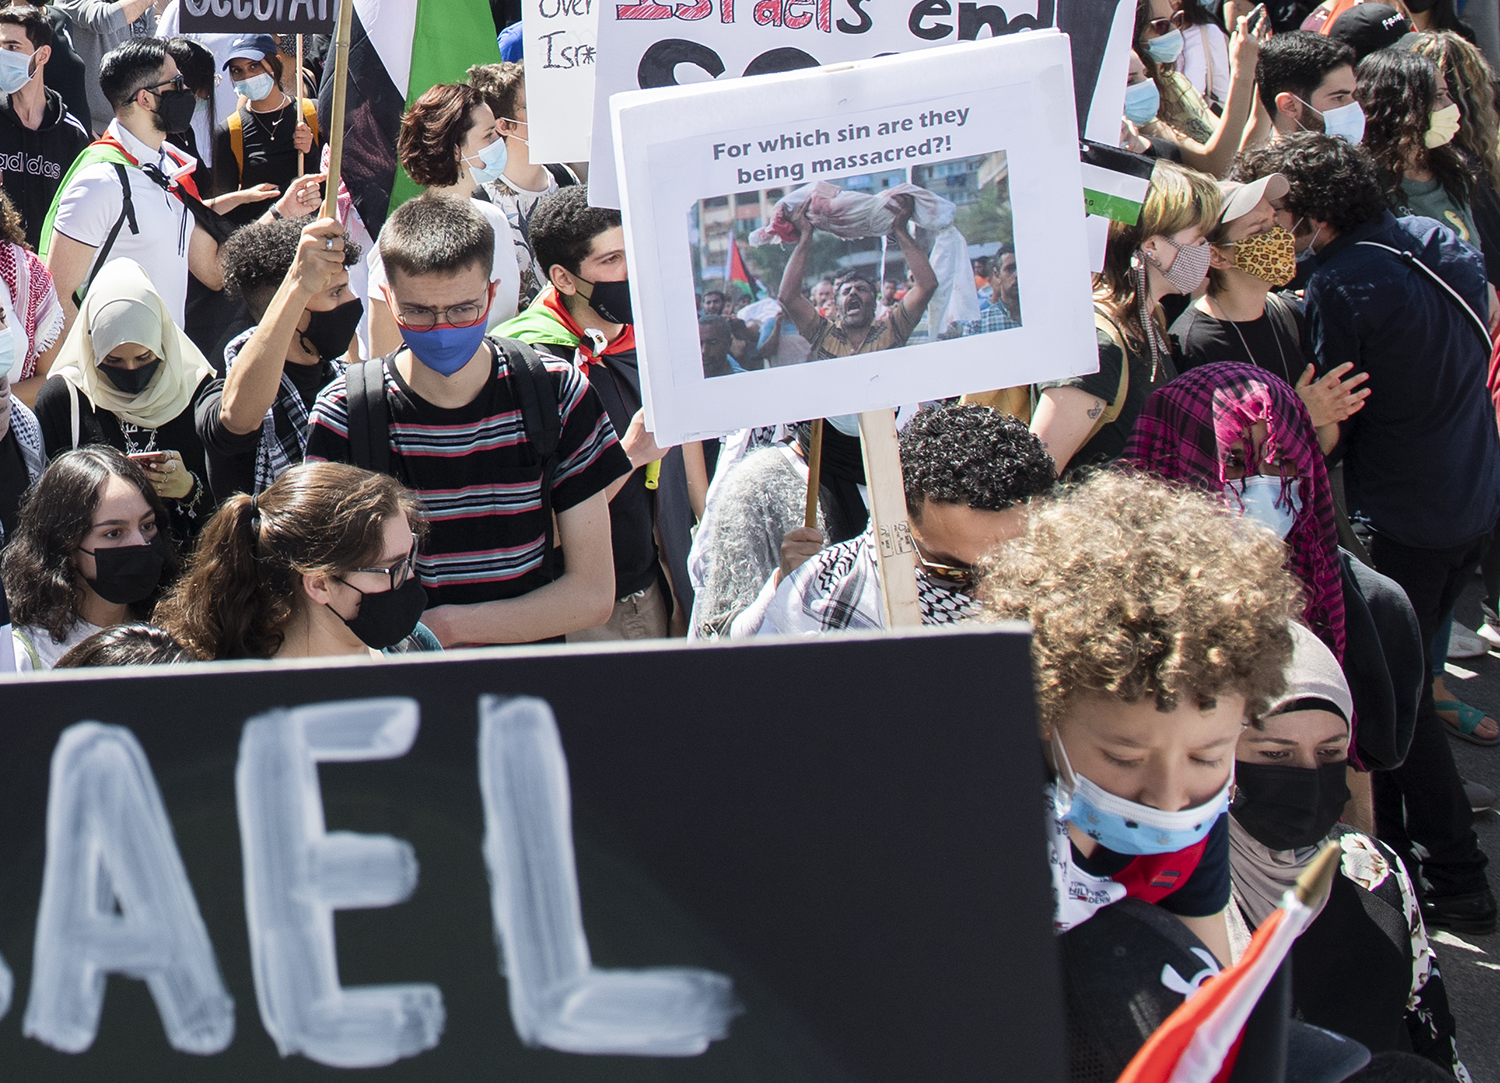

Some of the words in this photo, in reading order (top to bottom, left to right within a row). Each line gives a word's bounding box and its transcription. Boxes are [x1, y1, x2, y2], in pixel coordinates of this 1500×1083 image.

[712, 138, 753, 162] For
[757, 128, 830, 155] which
[836, 120, 872, 144] sin
[877, 118, 913, 139] are
[918, 104, 971, 133] they
[737, 156, 806, 189] being
[811, 136, 952, 176] massacred?!
